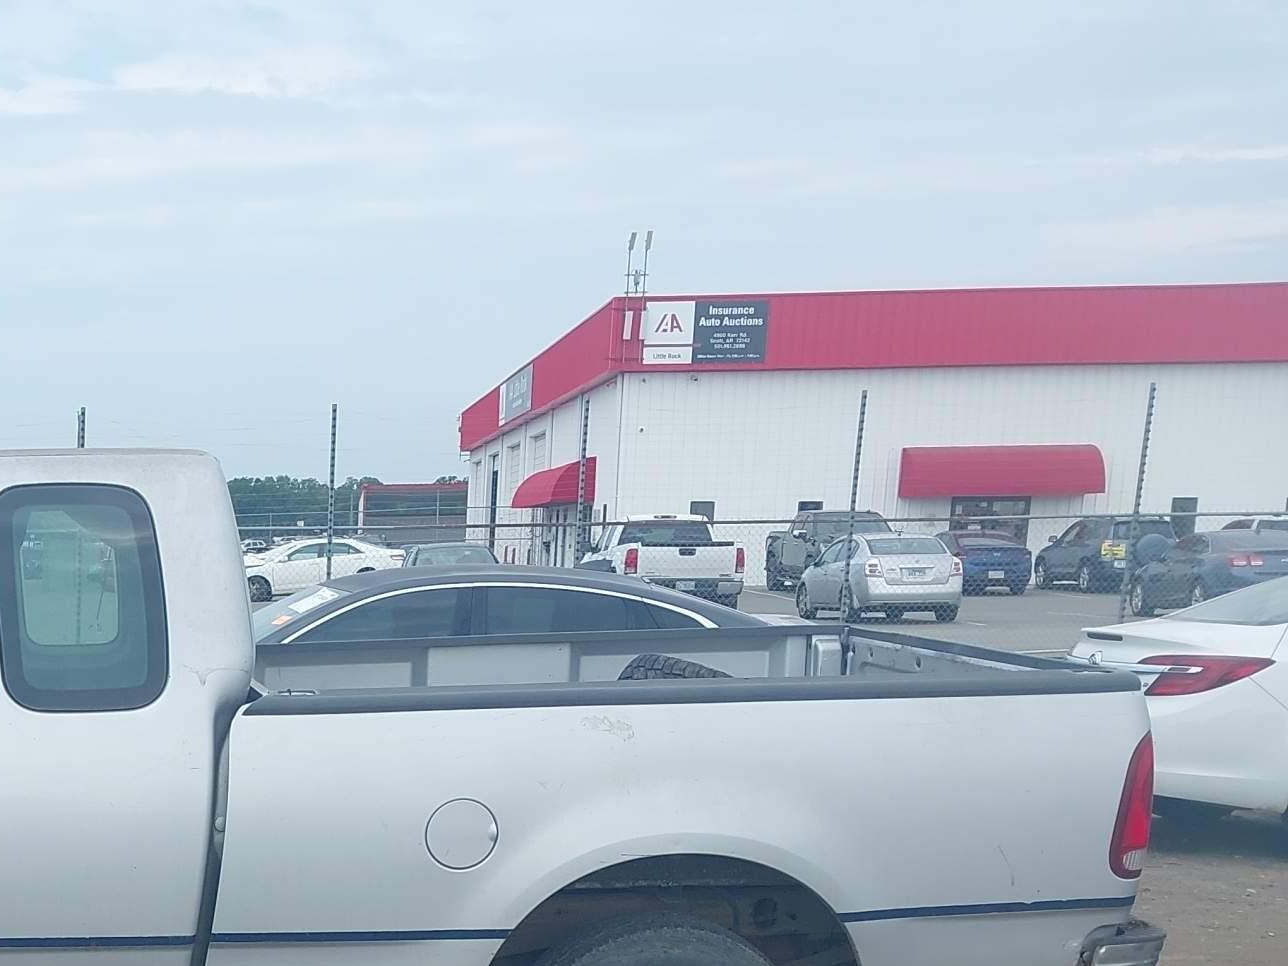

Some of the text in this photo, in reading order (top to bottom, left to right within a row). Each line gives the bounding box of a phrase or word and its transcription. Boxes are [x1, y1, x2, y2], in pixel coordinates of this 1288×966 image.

[709, 305, 755, 315] Insurance
[699, 316, 764, 327] Auto Auctions
